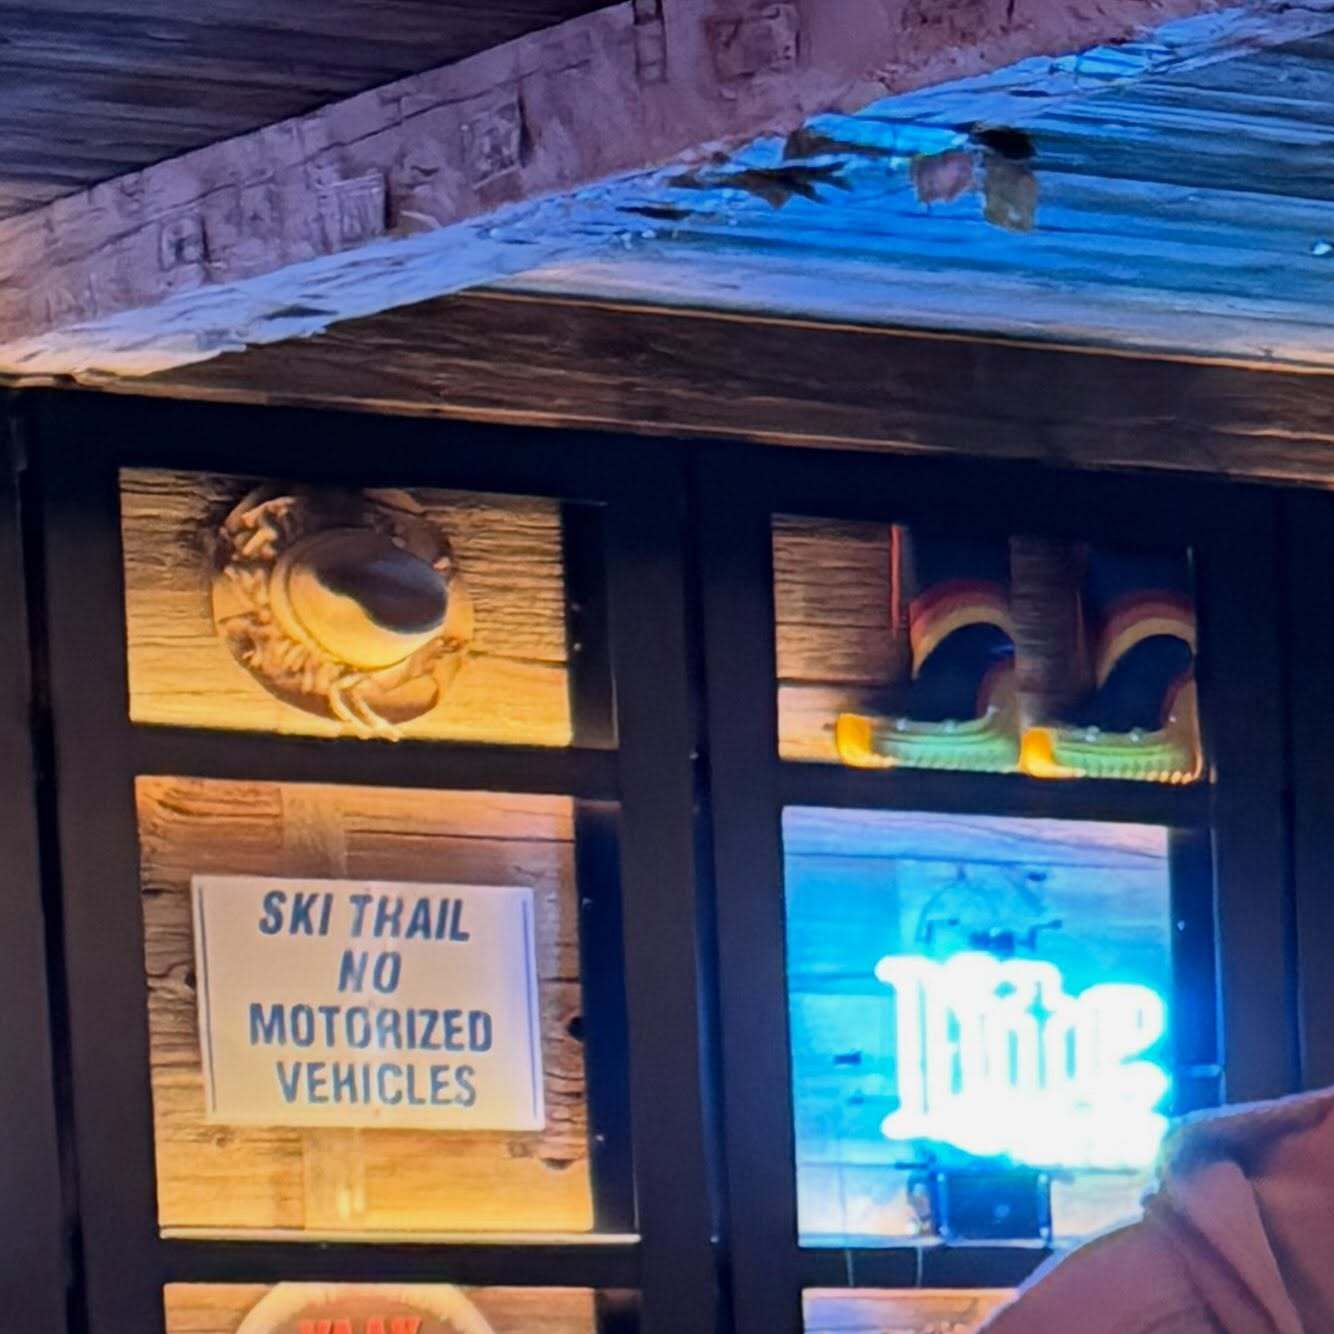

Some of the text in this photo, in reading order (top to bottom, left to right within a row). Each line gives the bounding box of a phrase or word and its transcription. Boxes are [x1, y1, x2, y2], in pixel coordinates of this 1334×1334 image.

[258, 890, 332, 937] SKI
[337, 949, 403, 994] NO
[249, 1002, 494, 1053] MOTORIZED
[275, 1060, 478, 1109] VEHICLES
